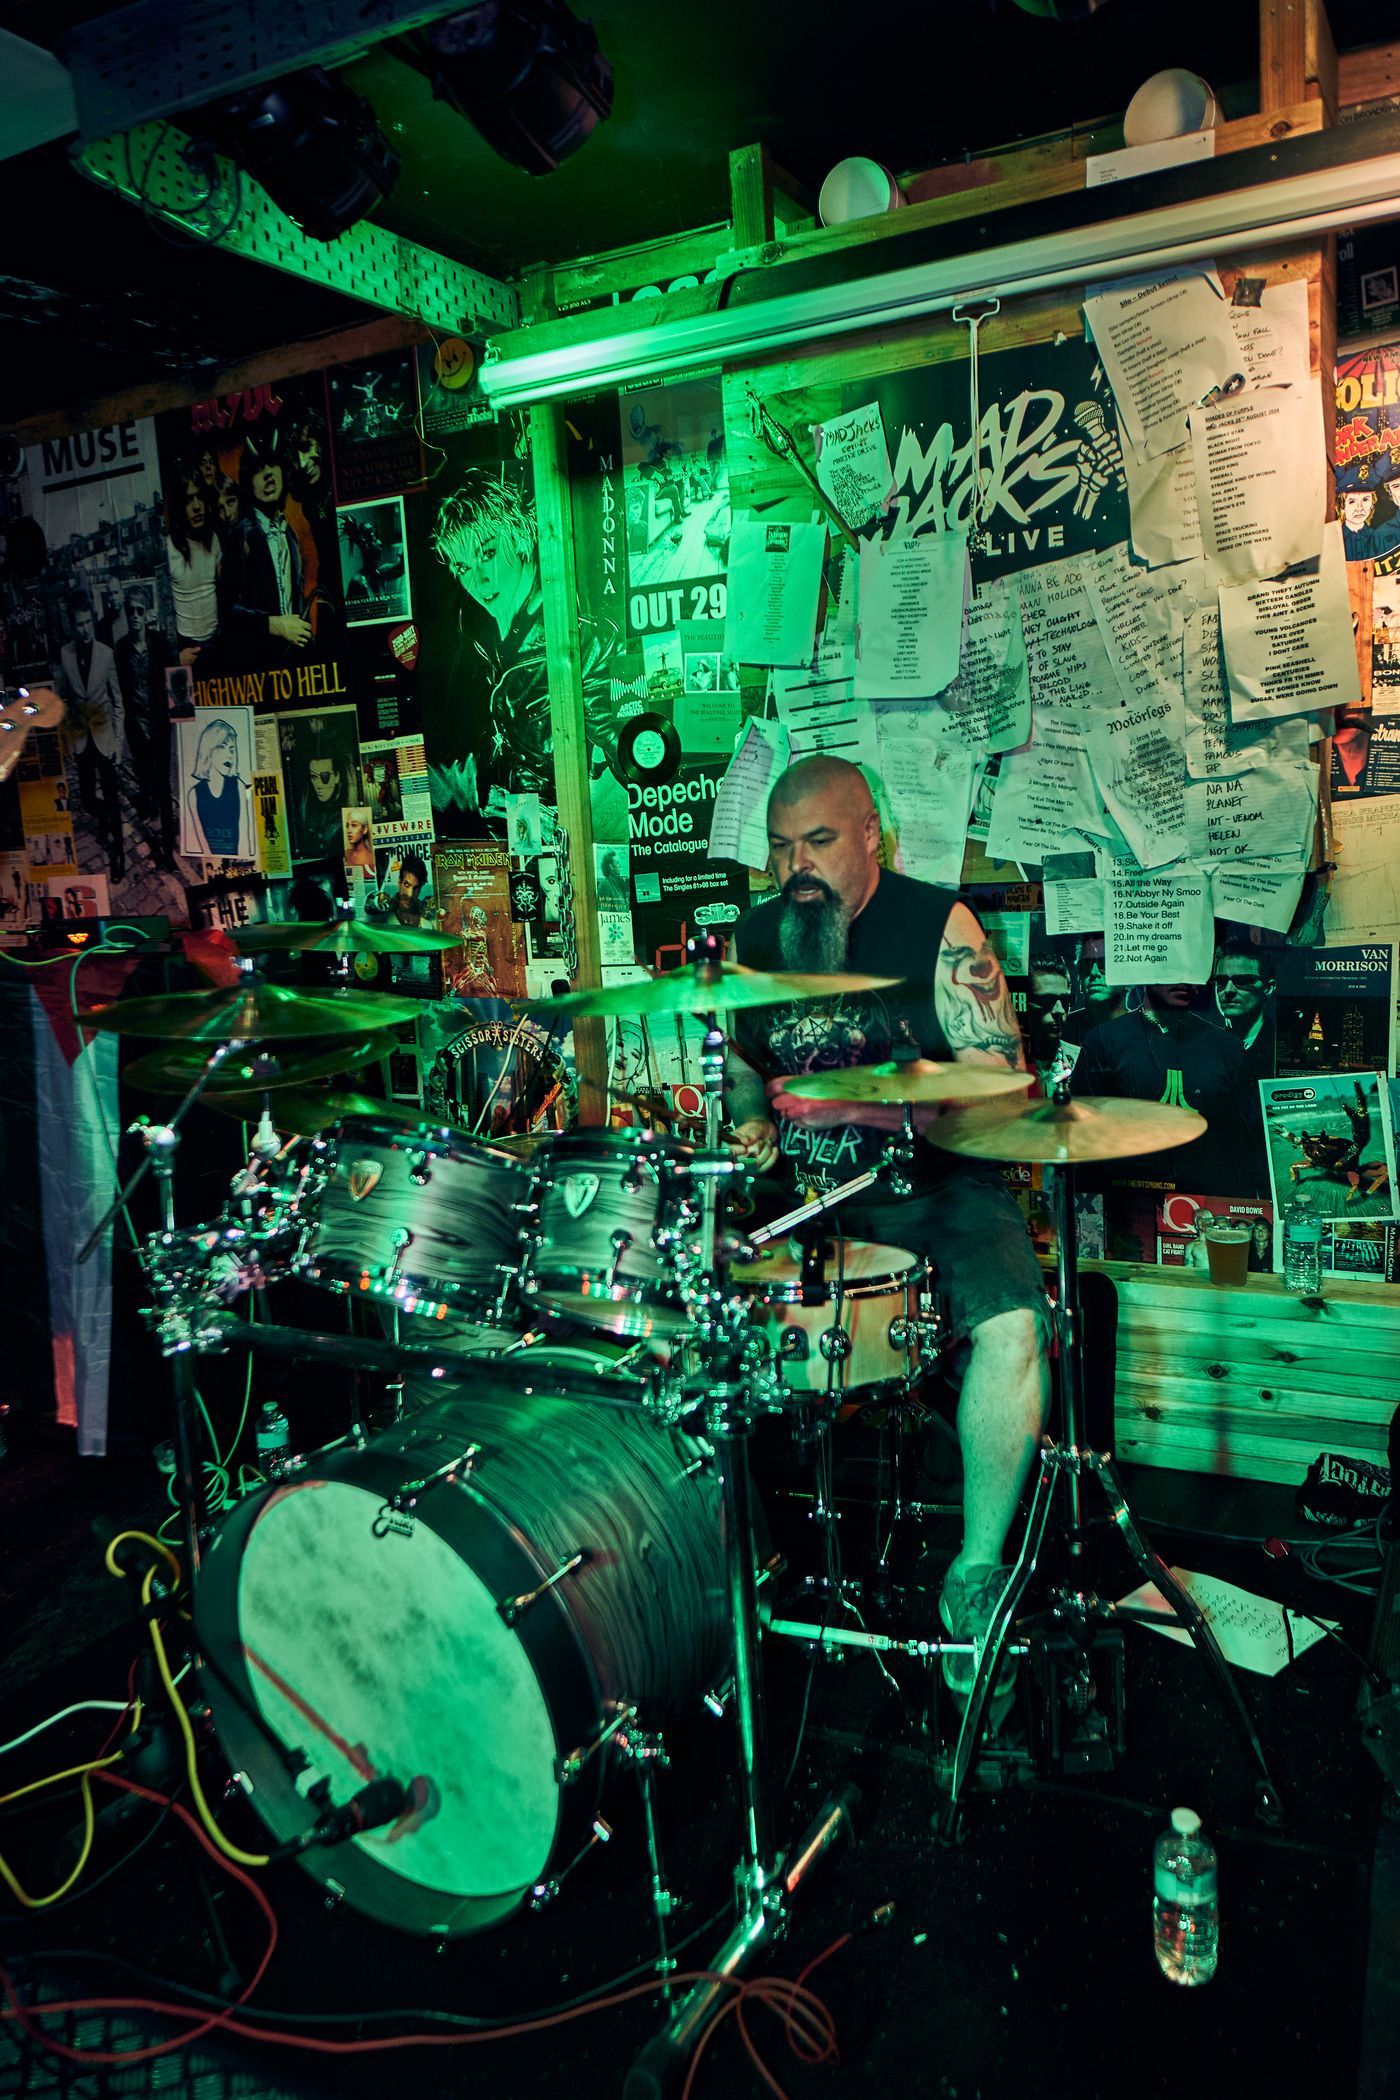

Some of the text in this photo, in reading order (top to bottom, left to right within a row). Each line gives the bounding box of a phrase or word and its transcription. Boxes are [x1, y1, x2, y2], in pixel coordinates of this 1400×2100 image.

[42, 420, 139, 475] MUSE
[895, 390, 1066, 498] MAD
[891, 438, 1084, 541] JACKS
[600, 455, 616, 595] MADONNA
[985, 525, 1064, 556] LIVE
[1248, 579, 1320, 601] GRAND THEFT AUTUMN
[1256, 588, 1313, 606] SIXTEEN CANDLES
[630, 589, 684, 630] OUT
[691, 583, 727, 620] 29
[1256, 612, 1270, 620] THIS
[1272, 610, 1288, 618] AINT
[1296, 603, 1315, 612] SCENE
[1258, 597, 1311, 613] DISLOYAL ORDER
[1255, 618, 1317, 636] YOUNG VOLCANOES
[1270, 629, 1305, 641] TAKE OVER
[1272, 637, 1304, 648] SATURDAY
[1273, 647, 1290, 656] DONT
[1292, 643, 1309, 651] CARE
[1265, 657, 1316, 672] PINK SEASHELL
[1272, 666, 1310, 678] CENTURIES
[270, 667, 294, 700] TO
[297, 662, 346, 696] HELL
[1039, 677, 1071, 690] BLOOD
[1260, 679, 1283, 688] THNKS
[1305, 671, 1324, 679] MMRS
[1277, 683, 1299, 692] SONGS
[1301, 679, 1321, 688] KNOW
[1296, 688, 1317, 697] GOING
[1318, 683, 1338, 692] DOWN
[1204, 750, 1242, 760] FAMOUS
[1206, 780, 1243, 795] NA NA
[1206, 796, 1248, 811] PLANET
[629, 808, 694, 839] Mode
[1208, 830, 1241, 842] HELEN
[631, 838, 709, 857] The Catalogue
[1209, 844, 1253, 857] NOT OK
[435, 853, 513, 872] IRON MAIDEN
[662, 877, 685, 885] Including
[698, 873, 715, 881] limited
[1137, 879, 1151, 887] the
[1153, 879, 1172, 888] Way
[674, 884, 692, 892] Singles
[1176, 888, 1201, 896] Smoo
[1114, 899, 1185, 909] 17.Outside Again
[202, 897, 249, 927] THE
[1114, 910, 1180, 919] 18.Be Your Best
[600, 913, 631, 928] James
[1114, 922, 1153, 930] 19.Shake
[1162, 921, 1173, 929] off
[1137, 934, 1150, 942] my
[1151, 932, 1182, 941] dreams
[1114, 944, 1140, 952] 21.Let
[1158, 944, 1168, 953] go
[1361, 949, 1389, 960] VAN
[1114, 955, 1168, 963] 22.Not Again
[1315, 961, 1389, 972] MORRISON
[451, 1029, 544, 1061] SCISSOR SISTERS
[674, 1086, 704, 1118] Q
[1162, 1196, 1264, 1233] Q DAVID BOWIE
